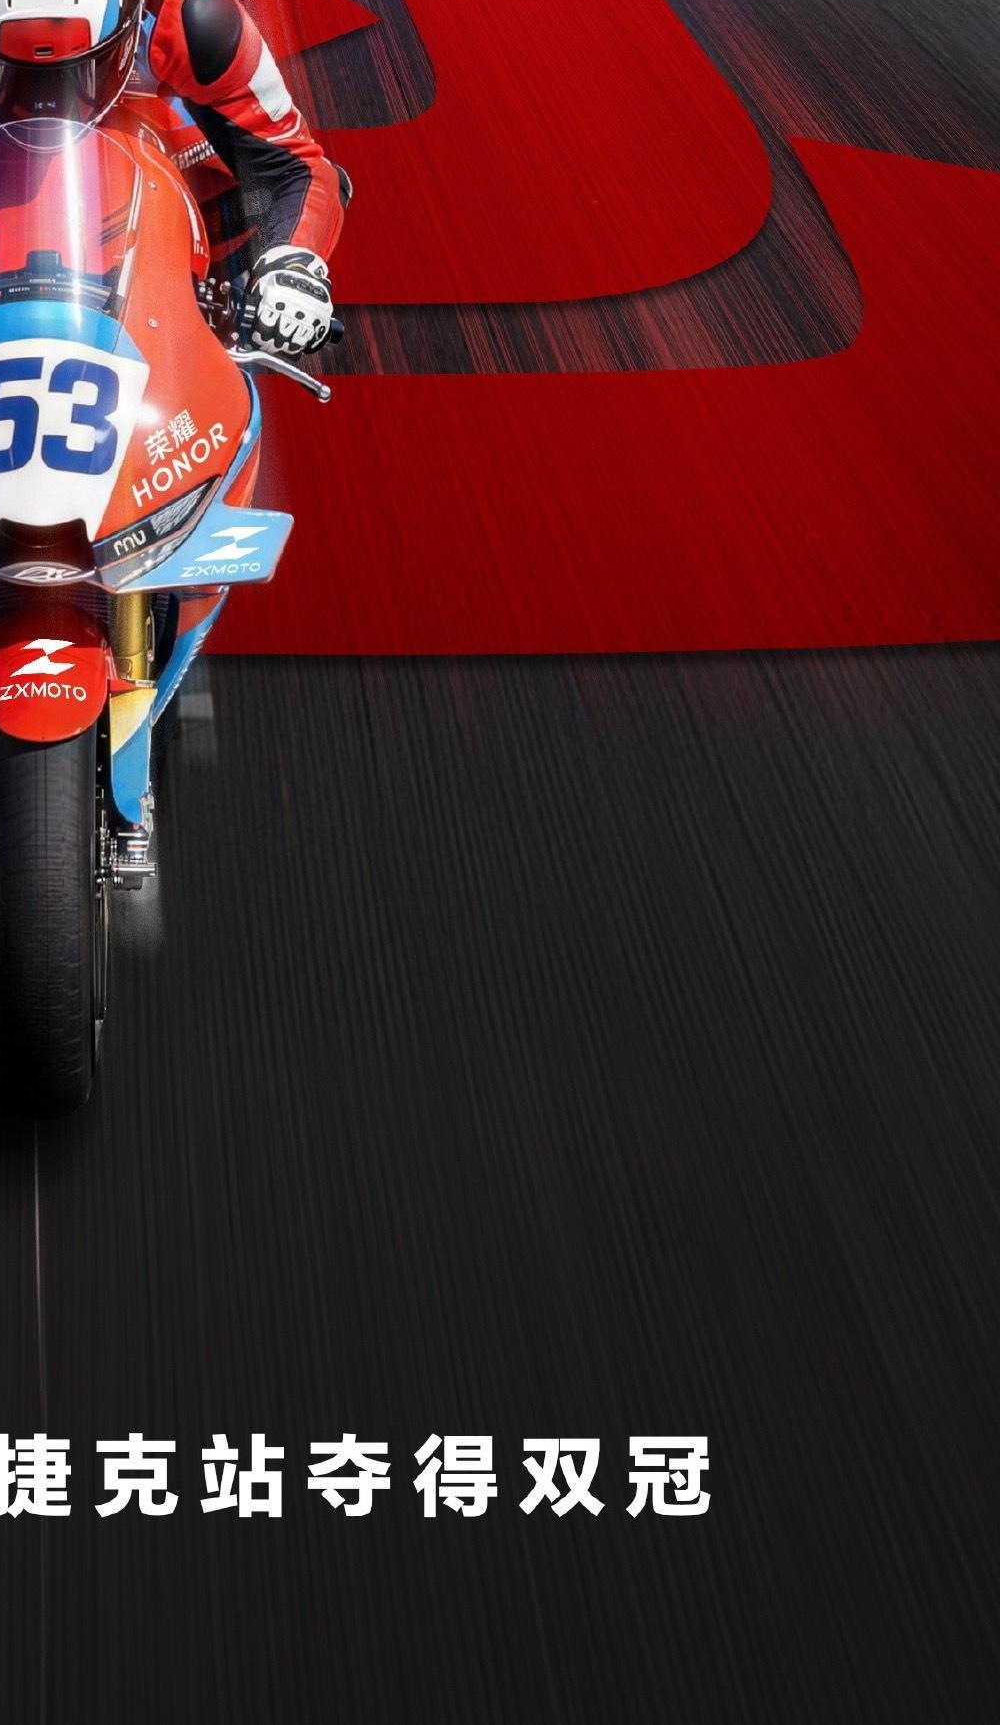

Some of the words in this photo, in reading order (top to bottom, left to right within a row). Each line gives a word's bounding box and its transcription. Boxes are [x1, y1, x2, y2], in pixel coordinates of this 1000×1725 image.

[130, 422, 230, 508] HONOR
[143, 408, 199, 465] 荣耀
[179, 561, 261, 578] ZXMOTO
